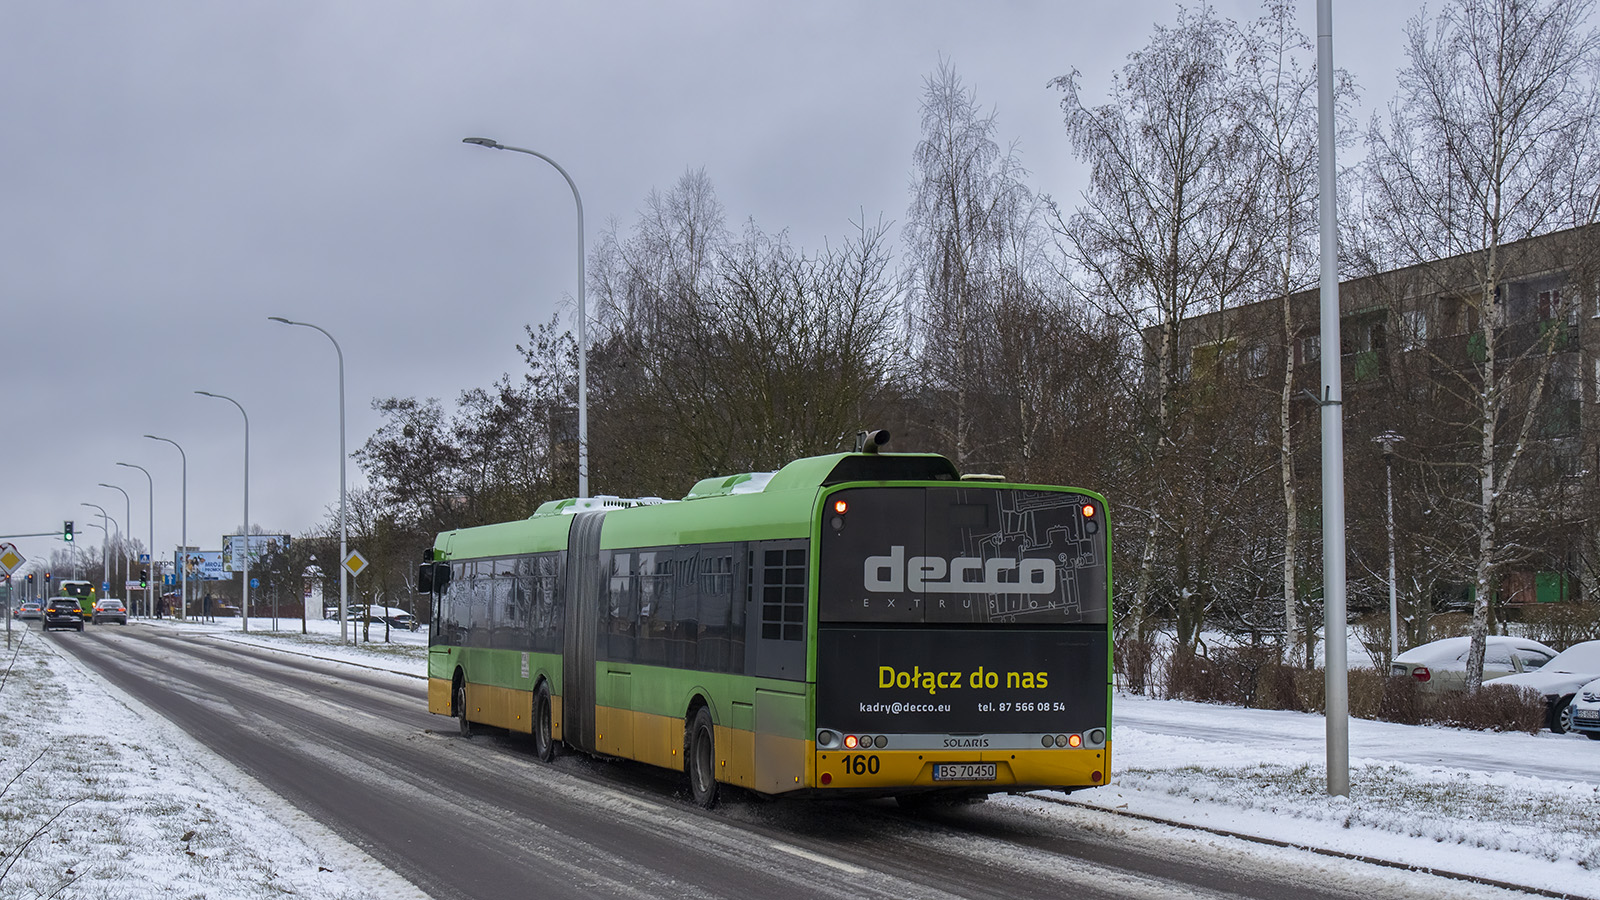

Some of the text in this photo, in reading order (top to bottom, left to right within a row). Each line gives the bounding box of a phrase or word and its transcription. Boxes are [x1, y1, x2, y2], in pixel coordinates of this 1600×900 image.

[864, 545, 1056, 594] decco
[864, 598, 1057, 609] EXTRUSION
[879, 665, 1048, 695] Dołącz do nas
[859, 701, 951, 715] kadry@decco.eu
[977, 702, 1066, 712] tel. 87 566 08 54
[943, 738, 989, 748] SOLARIS
[841, 755, 880, 775] 160
[940, 766, 995, 777] BS 70450
